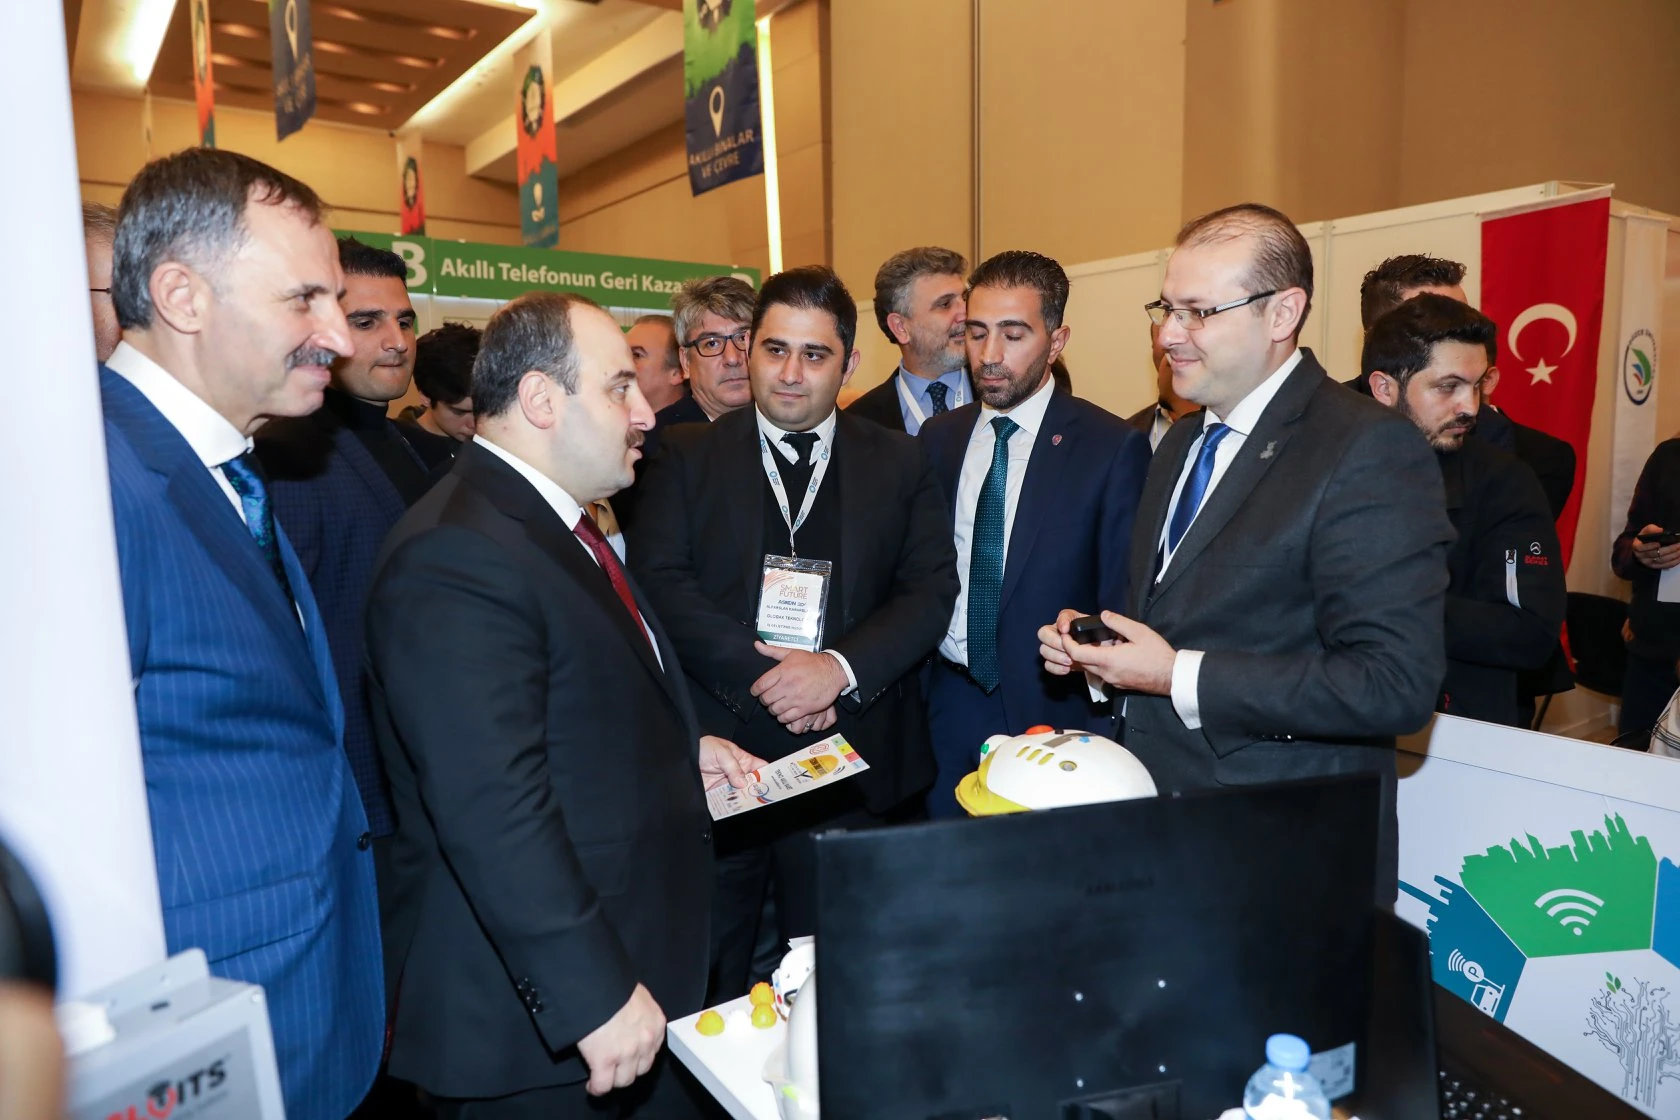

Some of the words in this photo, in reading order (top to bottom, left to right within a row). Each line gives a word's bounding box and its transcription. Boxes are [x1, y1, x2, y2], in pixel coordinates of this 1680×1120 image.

[440, 257, 495, 280] Akıllı
[498, 262, 596, 287] Telefonun
[600, 271, 638, 290] Geri
[642, 275, 684, 293] Kaza
[780, 584, 808, 594] SMART
[780, 590, 808, 600] FUTURE
